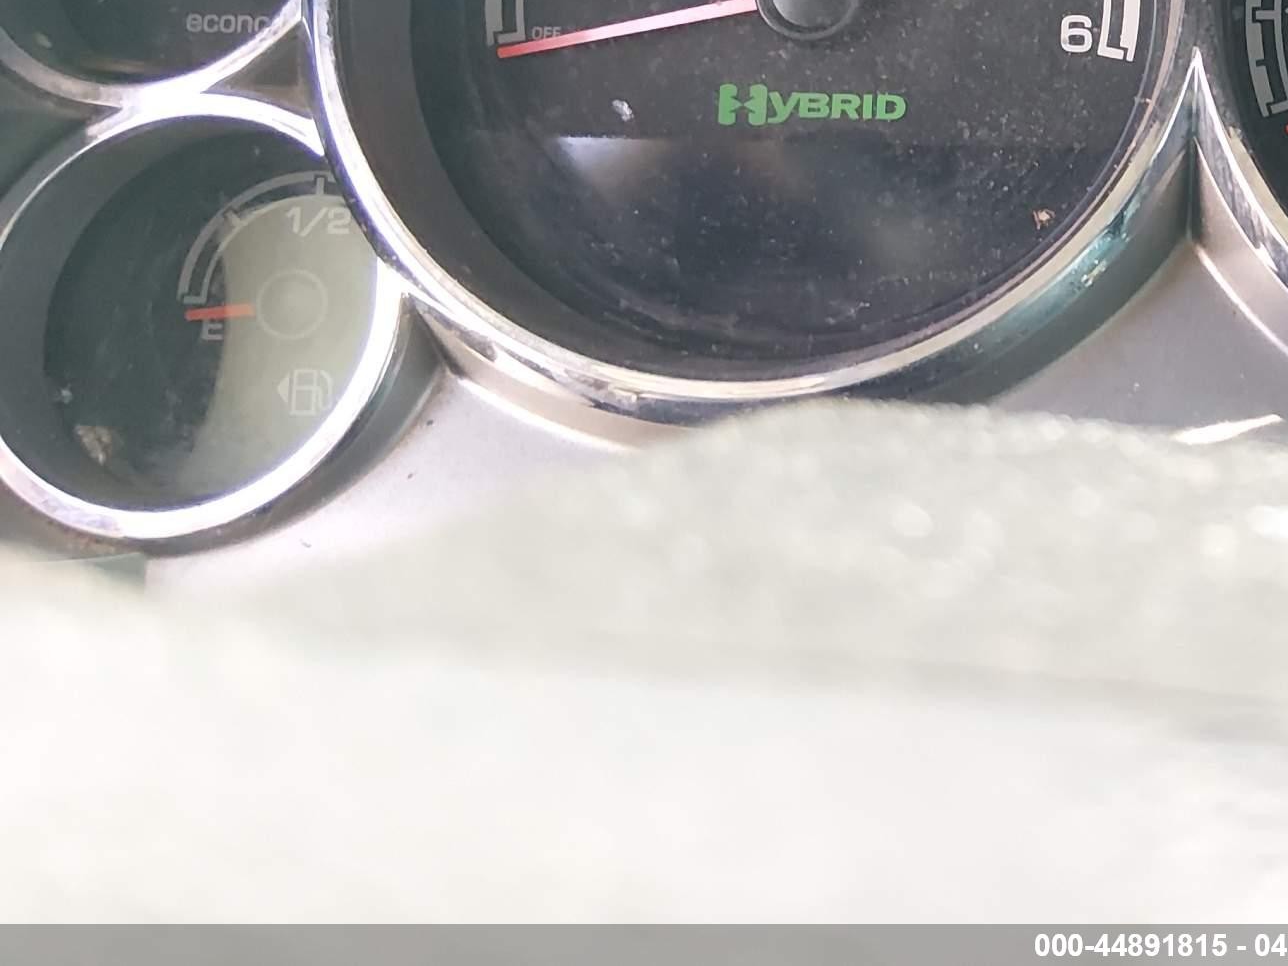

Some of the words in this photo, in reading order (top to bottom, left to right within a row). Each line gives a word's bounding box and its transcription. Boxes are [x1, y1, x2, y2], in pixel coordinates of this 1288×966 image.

[531, 26, 562, 41] OFF
[1060, 16, 1093, 53] 6
[286, 207, 353, 237] 1/2
